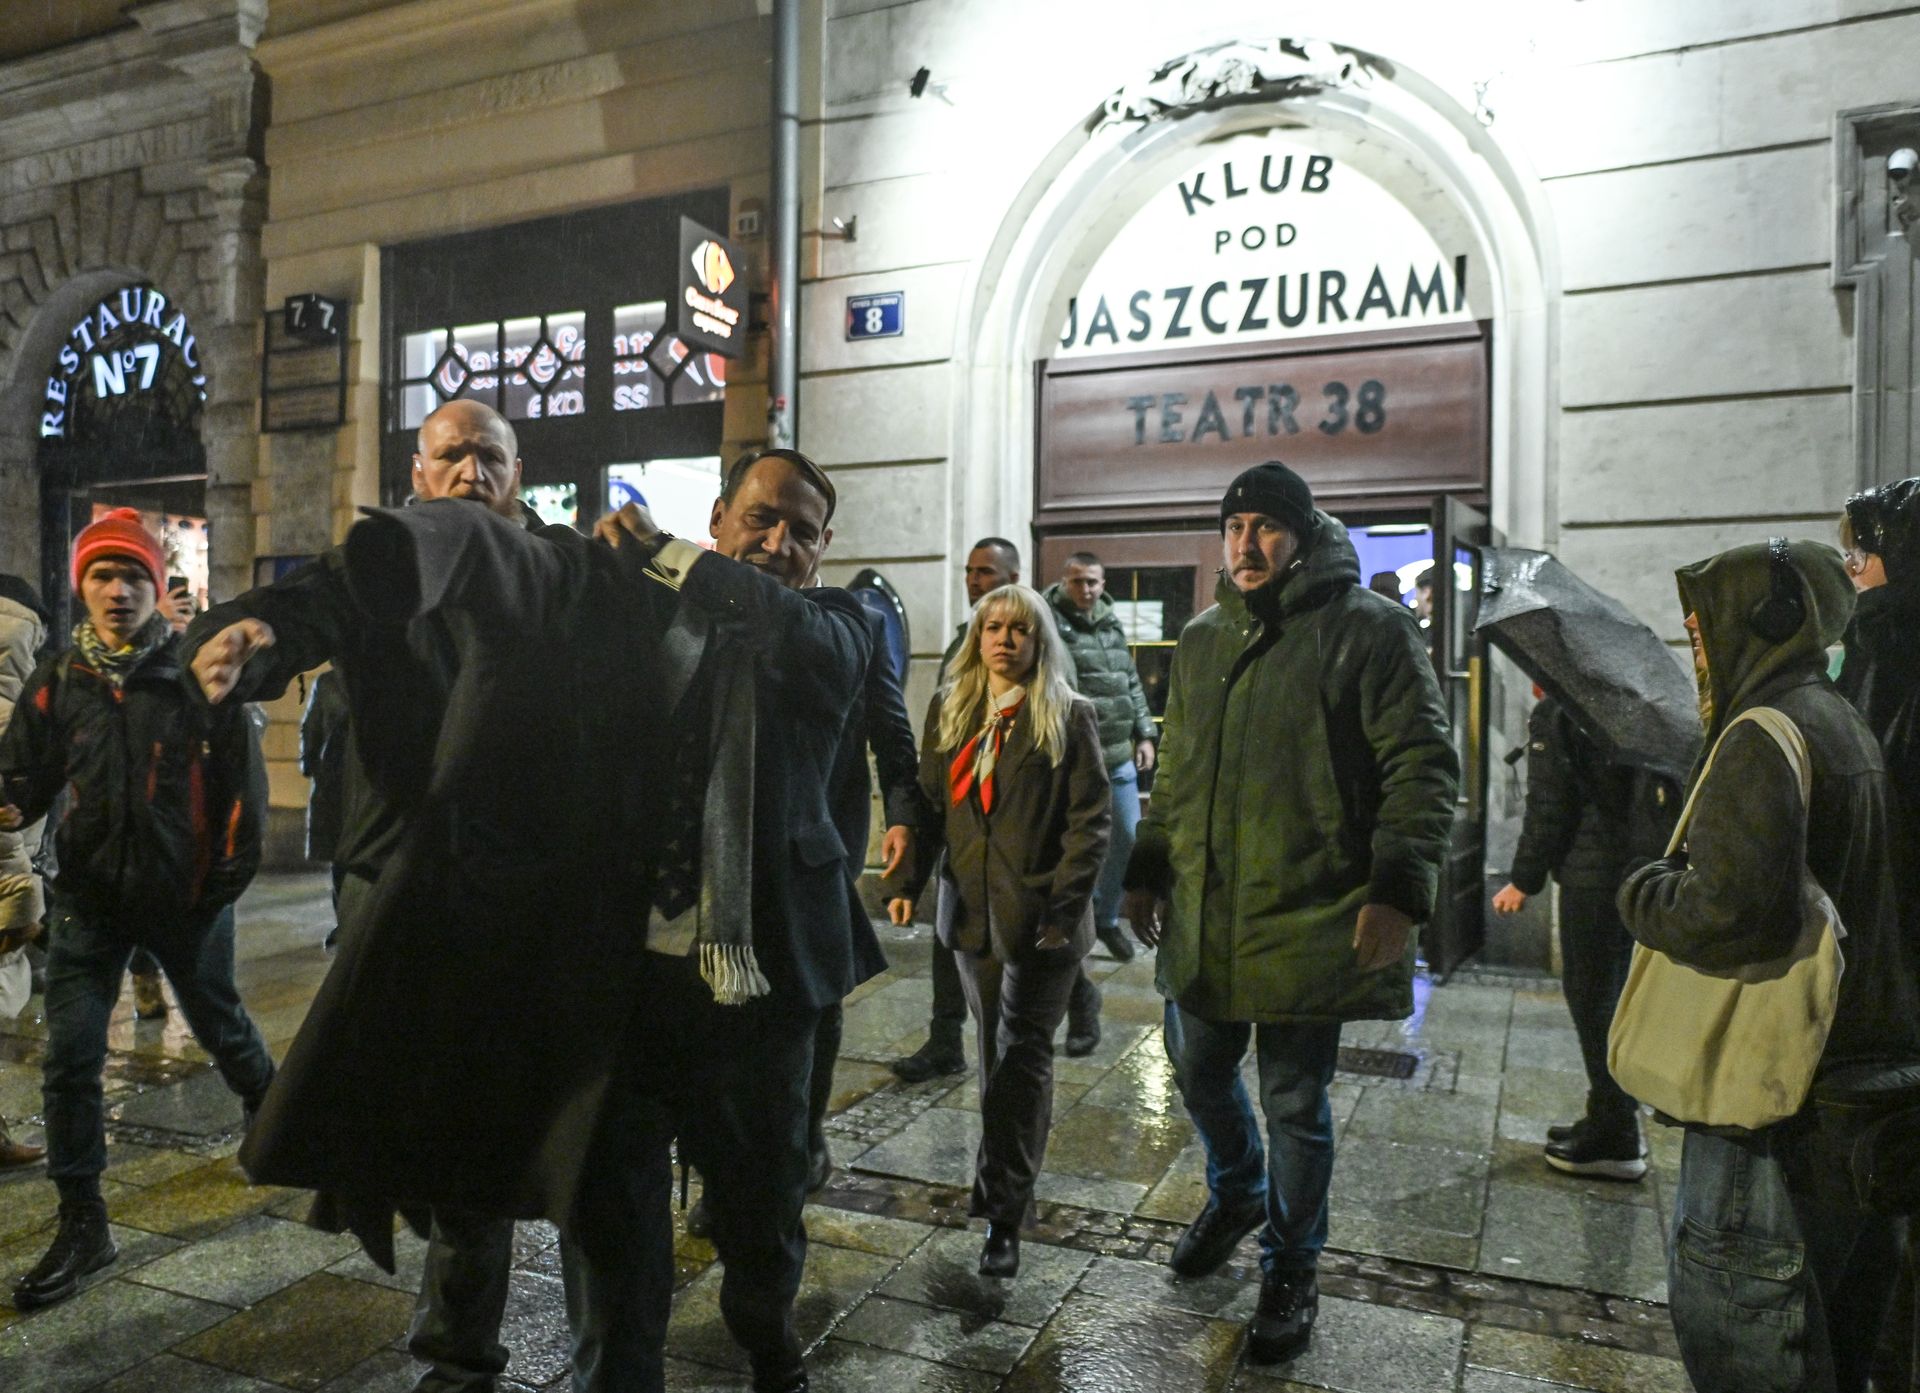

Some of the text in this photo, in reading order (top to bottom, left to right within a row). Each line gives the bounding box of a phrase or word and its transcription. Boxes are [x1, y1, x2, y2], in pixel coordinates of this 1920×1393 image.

[1178, 154, 1334, 216] KLUB
[1214, 222, 1298, 254] POD
[865, 306, 883, 334] 8
[1060, 254, 1468, 351] JASZCZURAMI
[1127, 378, 1387, 446] TEATR 38
